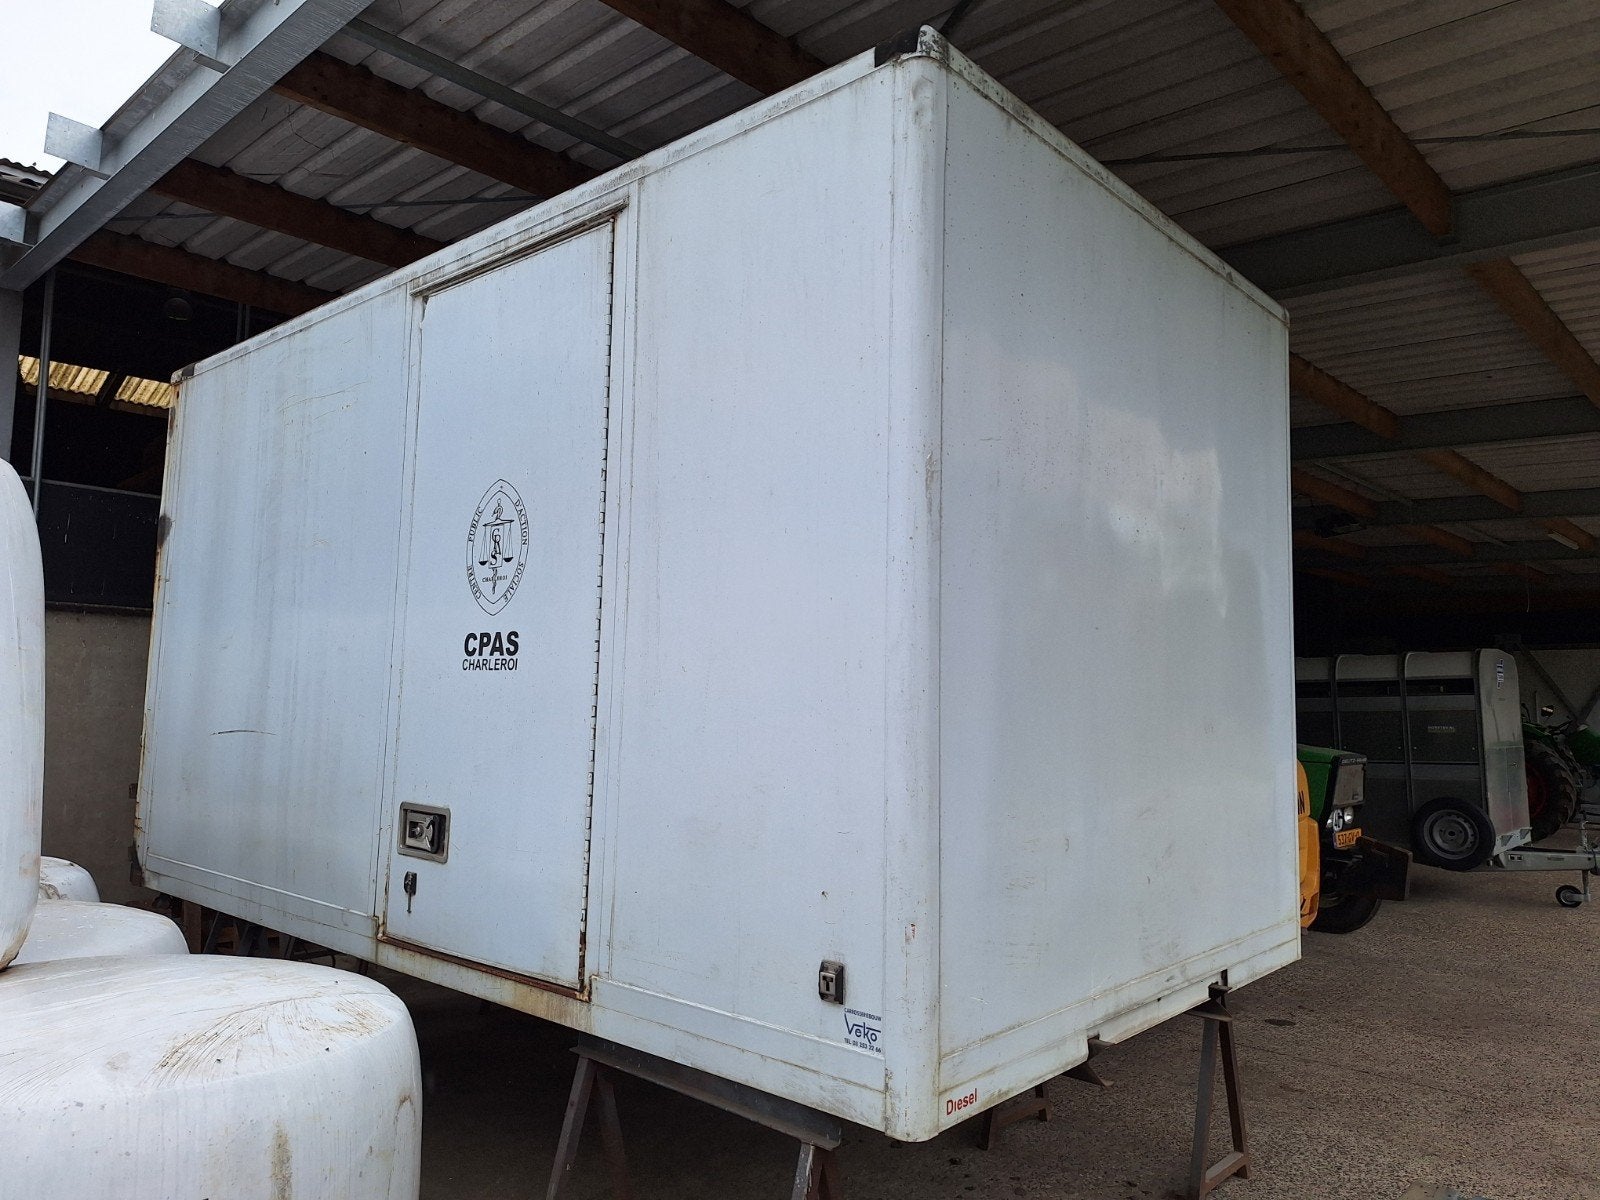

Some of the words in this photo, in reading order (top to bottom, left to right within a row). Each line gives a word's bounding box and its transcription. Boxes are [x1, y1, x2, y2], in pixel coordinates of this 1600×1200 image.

[468, 506, 484, 542] PUBLIC
[514, 498, 528, 546] D'ACTION
[503, 561, 525, 603] SOCIALE
[464, 630, 520, 657] CPAS
[462, 657, 519, 671] CHARLEROI
[844, 1013, 882, 1045] Veko
[946, 1088, 978, 1116] Diesel
